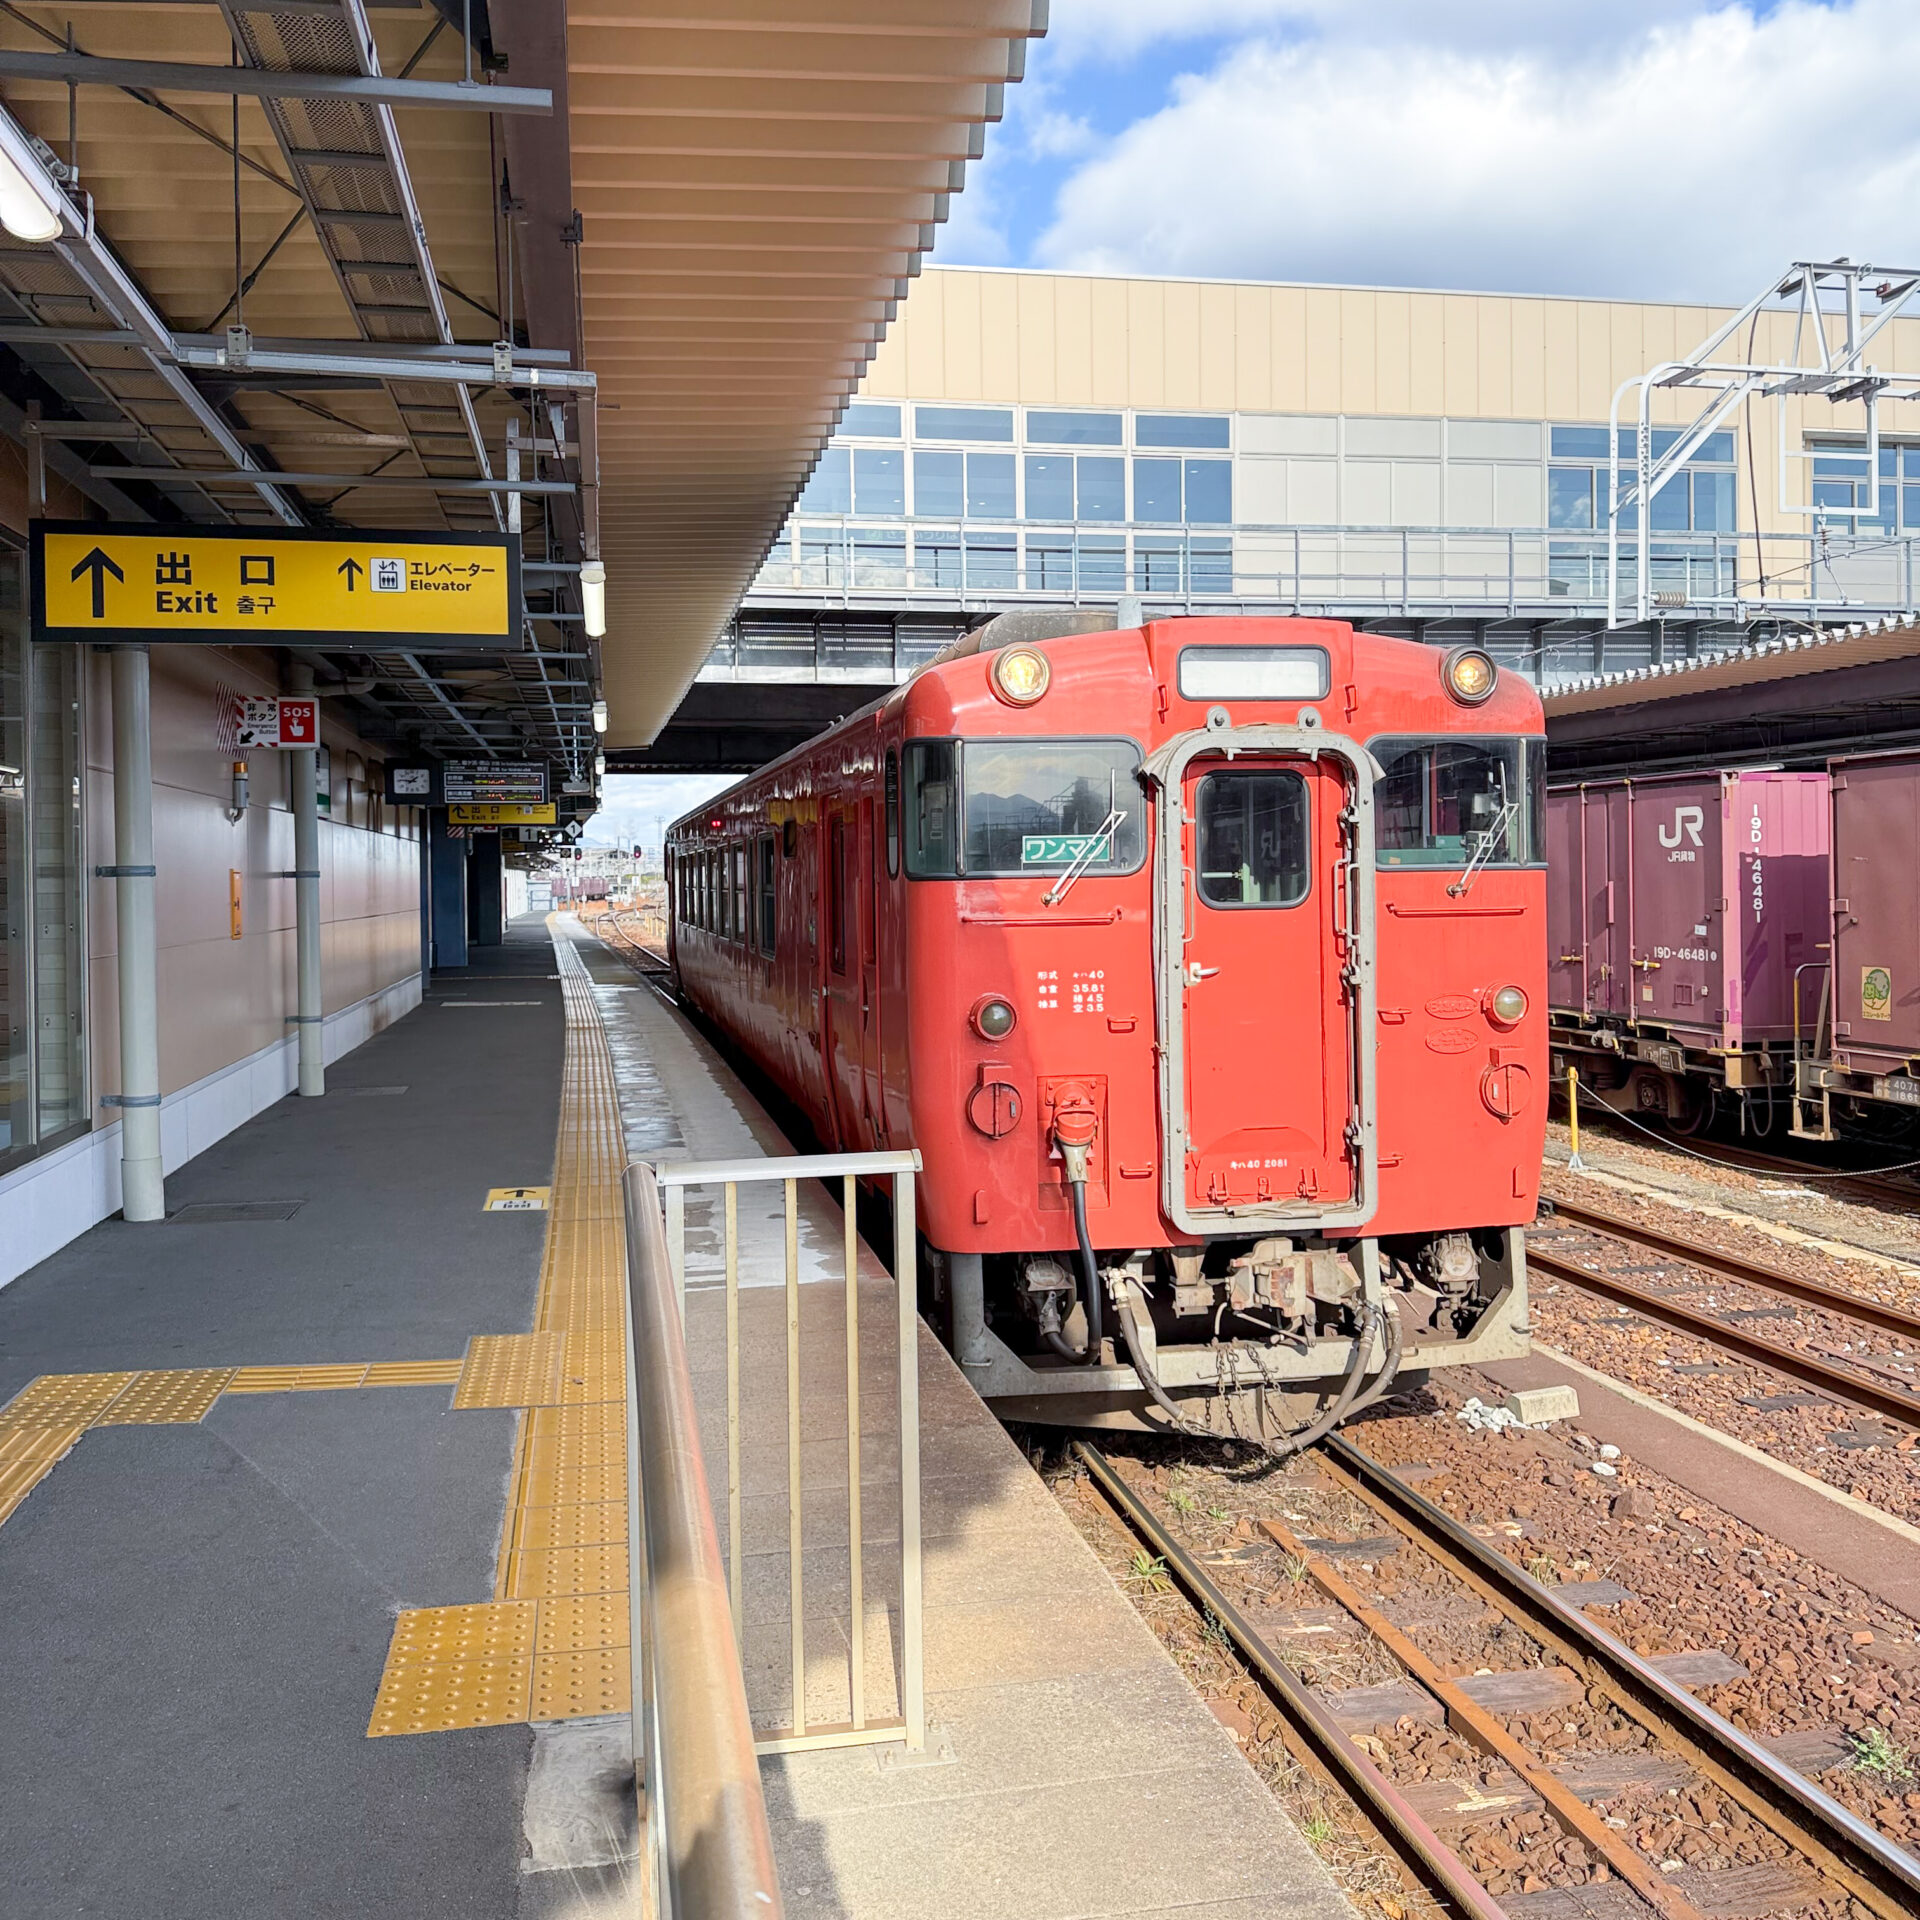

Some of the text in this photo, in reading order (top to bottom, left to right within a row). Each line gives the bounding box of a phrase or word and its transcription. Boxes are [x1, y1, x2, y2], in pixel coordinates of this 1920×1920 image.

[155, 552, 276, 586] 出口
[410, 562, 495, 577] エレベーター
[410, 579, 472, 592] Elevator
[156, 590, 218, 614] Exit
[236, 595, 277, 615] 출구
[247, 703, 277, 712] 非常
[283, 707, 311, 718] SOS
[247, 713, 277, 722] ボタン
[472, 806, 500, 814] 出口
[1658, 805, 1704, 849] JR
[1026, 838, 1108, 860] ワンマン
[1653, 946, 1709, 961] 19D-46481
[1037, 970, 1058, 980] 形式
[1230, 1158, 1288, 1170] キハ40 2081
